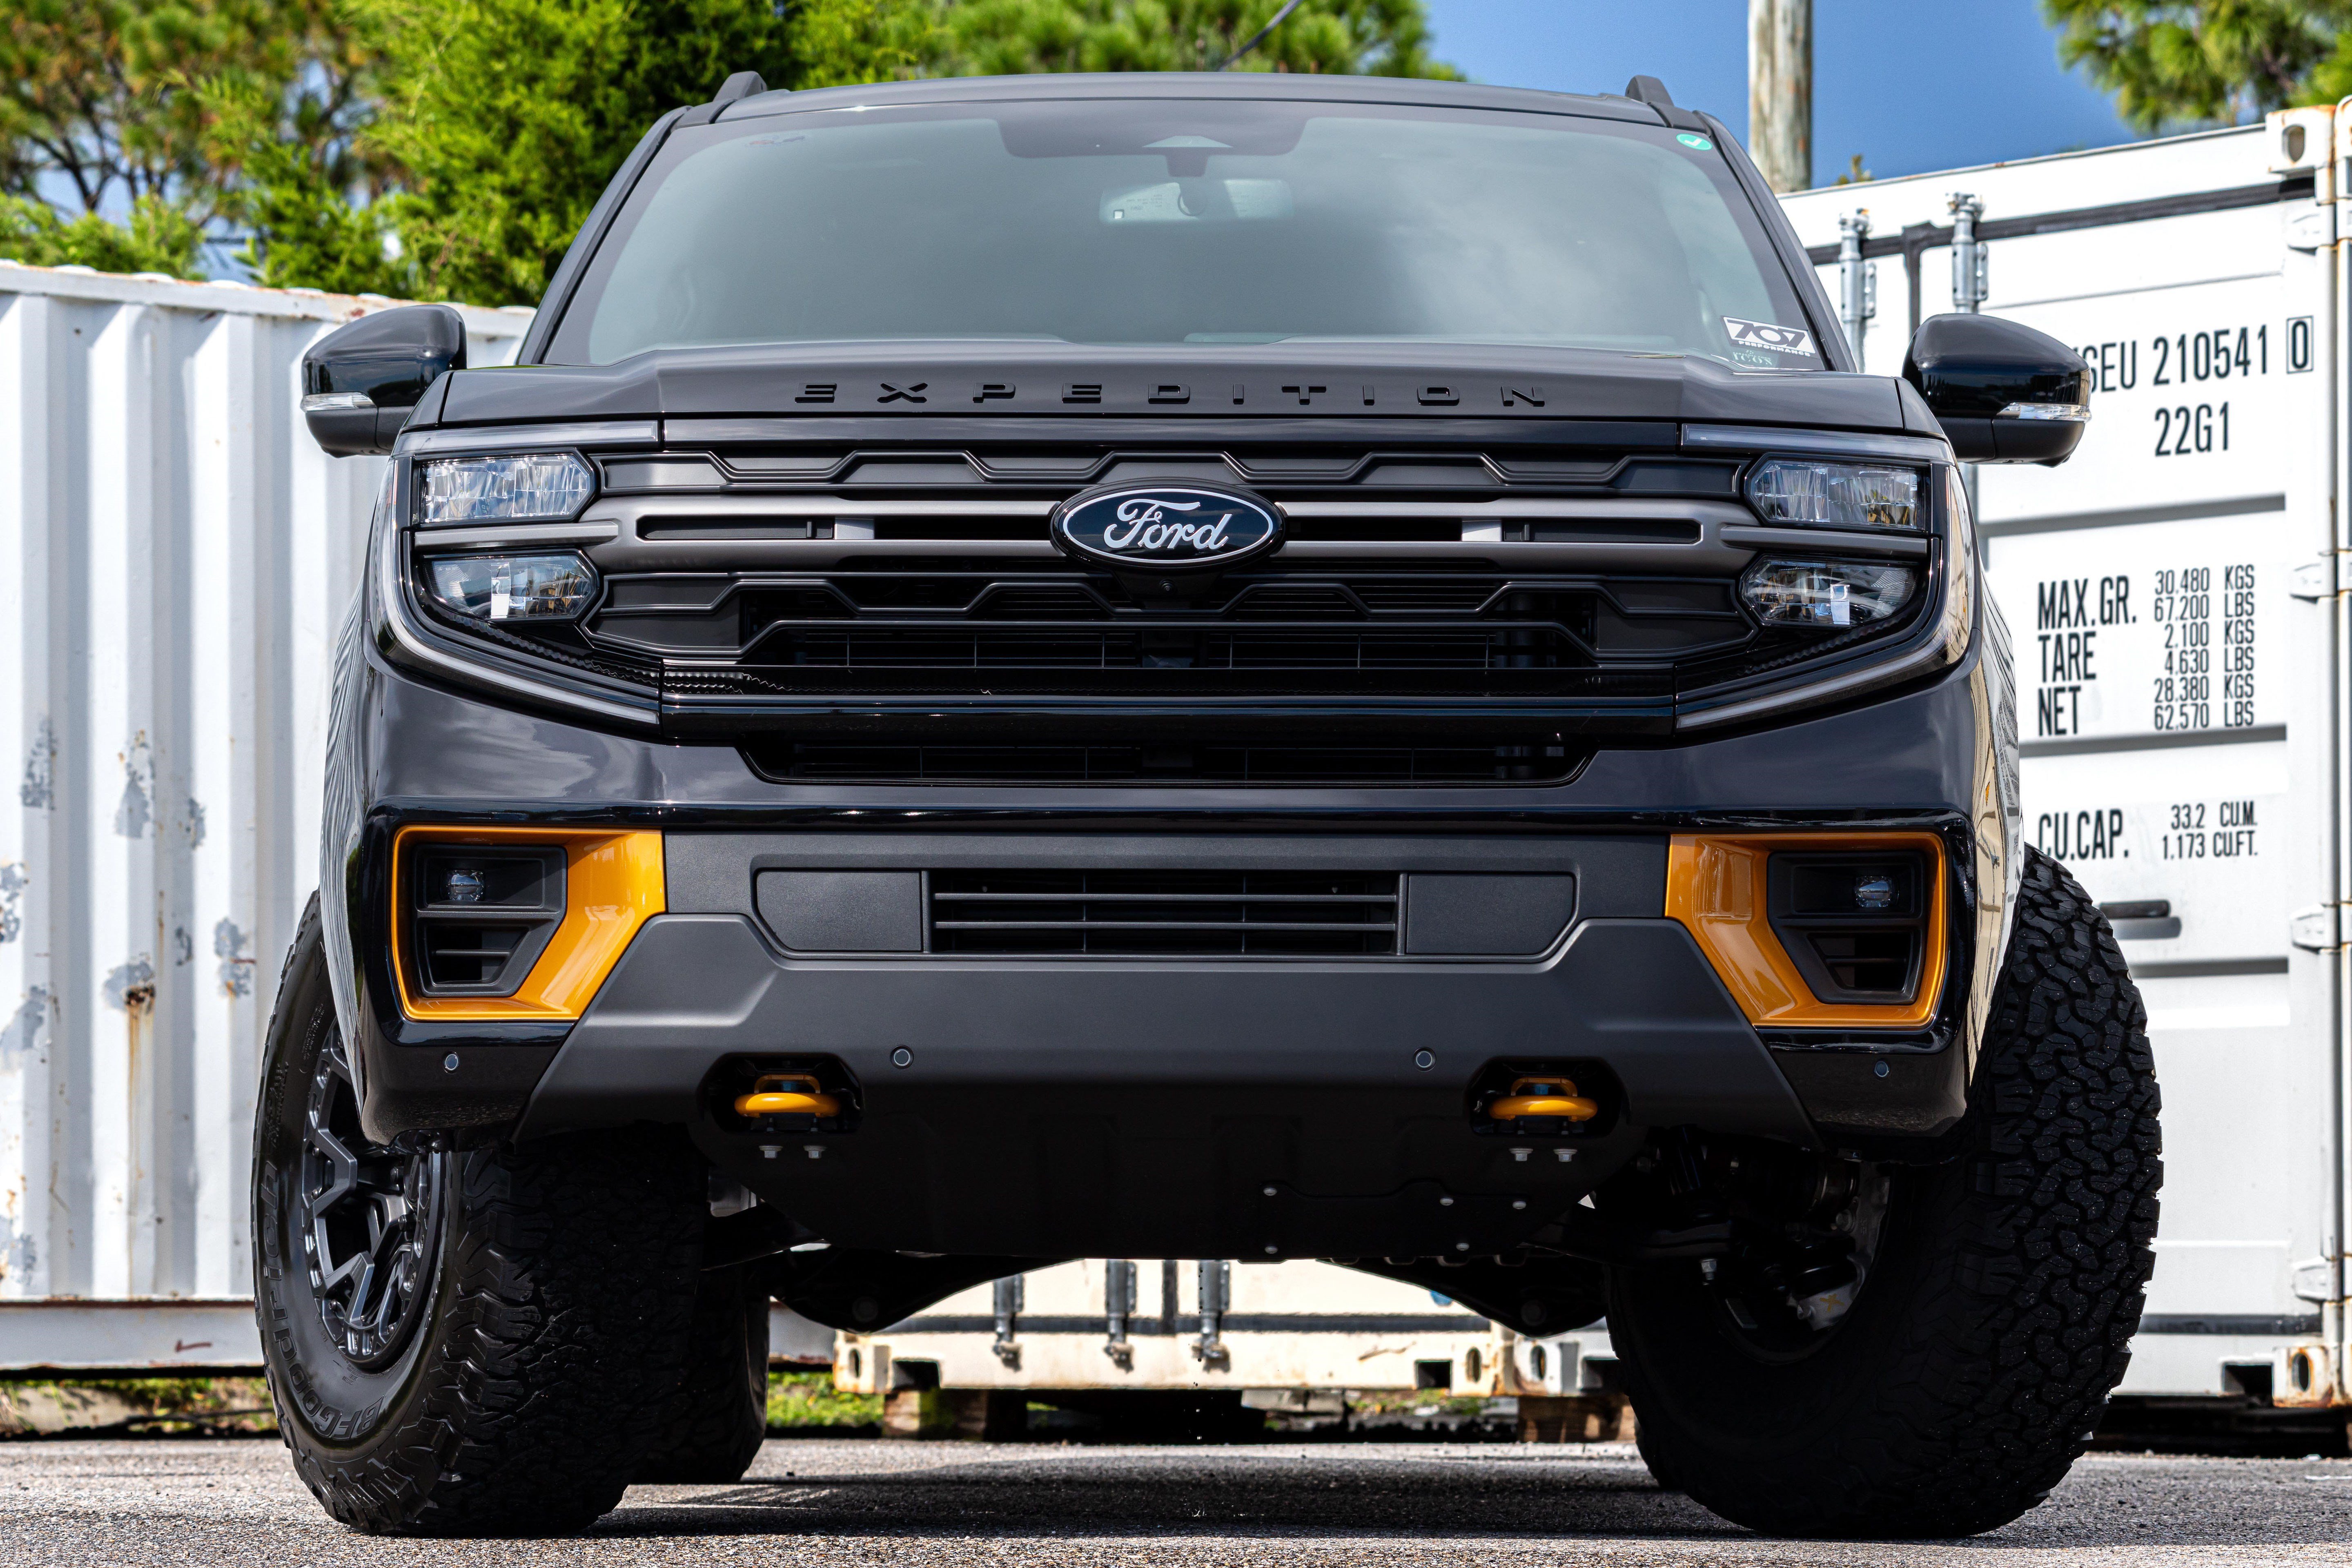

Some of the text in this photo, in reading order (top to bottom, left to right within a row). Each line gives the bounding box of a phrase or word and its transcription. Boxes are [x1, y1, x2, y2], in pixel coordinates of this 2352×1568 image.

[1738, 340, 1811, 357] PERFORMANCE
[2073, 341, 2136, 393] SEU
[2153, 325, 2267, 385] 210541
[795, 382, 1545, 407] EXPEDITION
[2155, 402, 2228, 457] 22G1
[1104, 499, 1232, 550] Ford
[2038, 575, 2136, 630] MAX.GR.
[2225, 564, 2254, 590] KGS
[2225, 592, 2254, 618] LBS
[2038, 631, 2096, 683] TARE
[2225, 619, 2254, 645] KGS
[2225, 646, 2254, 672] LBS
[2038, 685, 2081, 736] NET
[2225, 673, 2254, 699] KGS
[2225, 701, 2254, 727] LBS
[2038, 809, 2129, 861] CU.CAP.
[2171, 803, 2205, 830] 33.2
